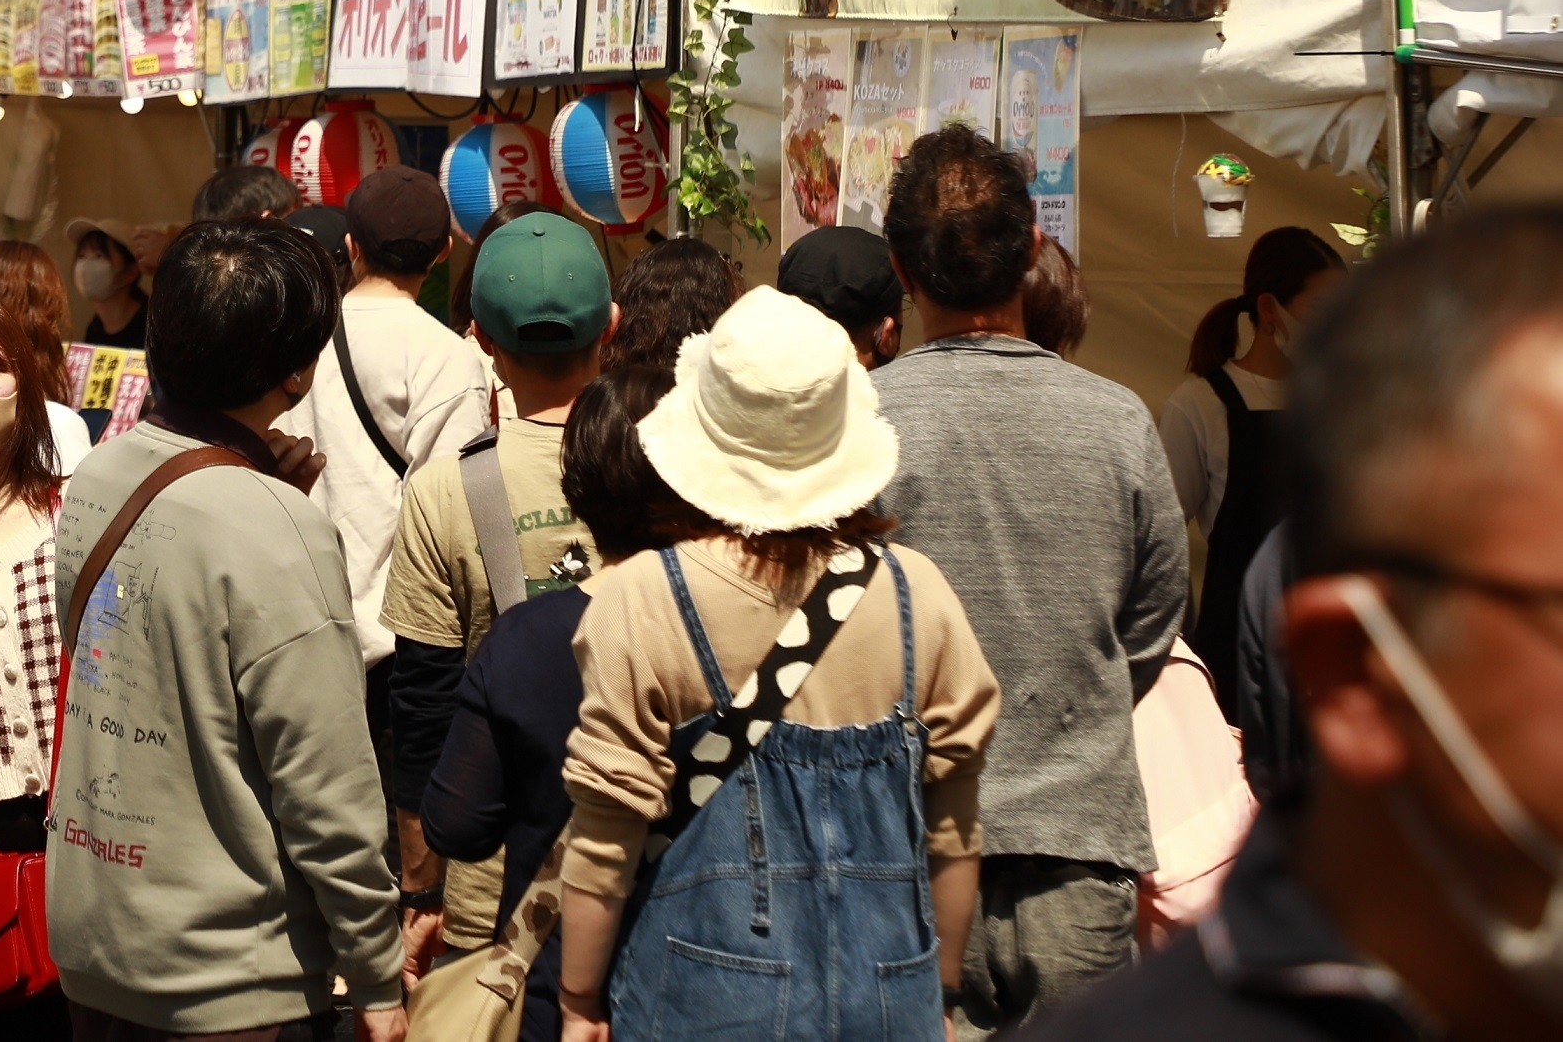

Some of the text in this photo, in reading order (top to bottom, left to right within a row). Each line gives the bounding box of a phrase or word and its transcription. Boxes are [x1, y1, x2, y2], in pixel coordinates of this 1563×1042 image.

[500, 144, 538, 204] Orio
[615, 113, 646, 201] Orion
[134, 727, 168, 748] DAY
[64, 817, 147, 870] GONZALES
